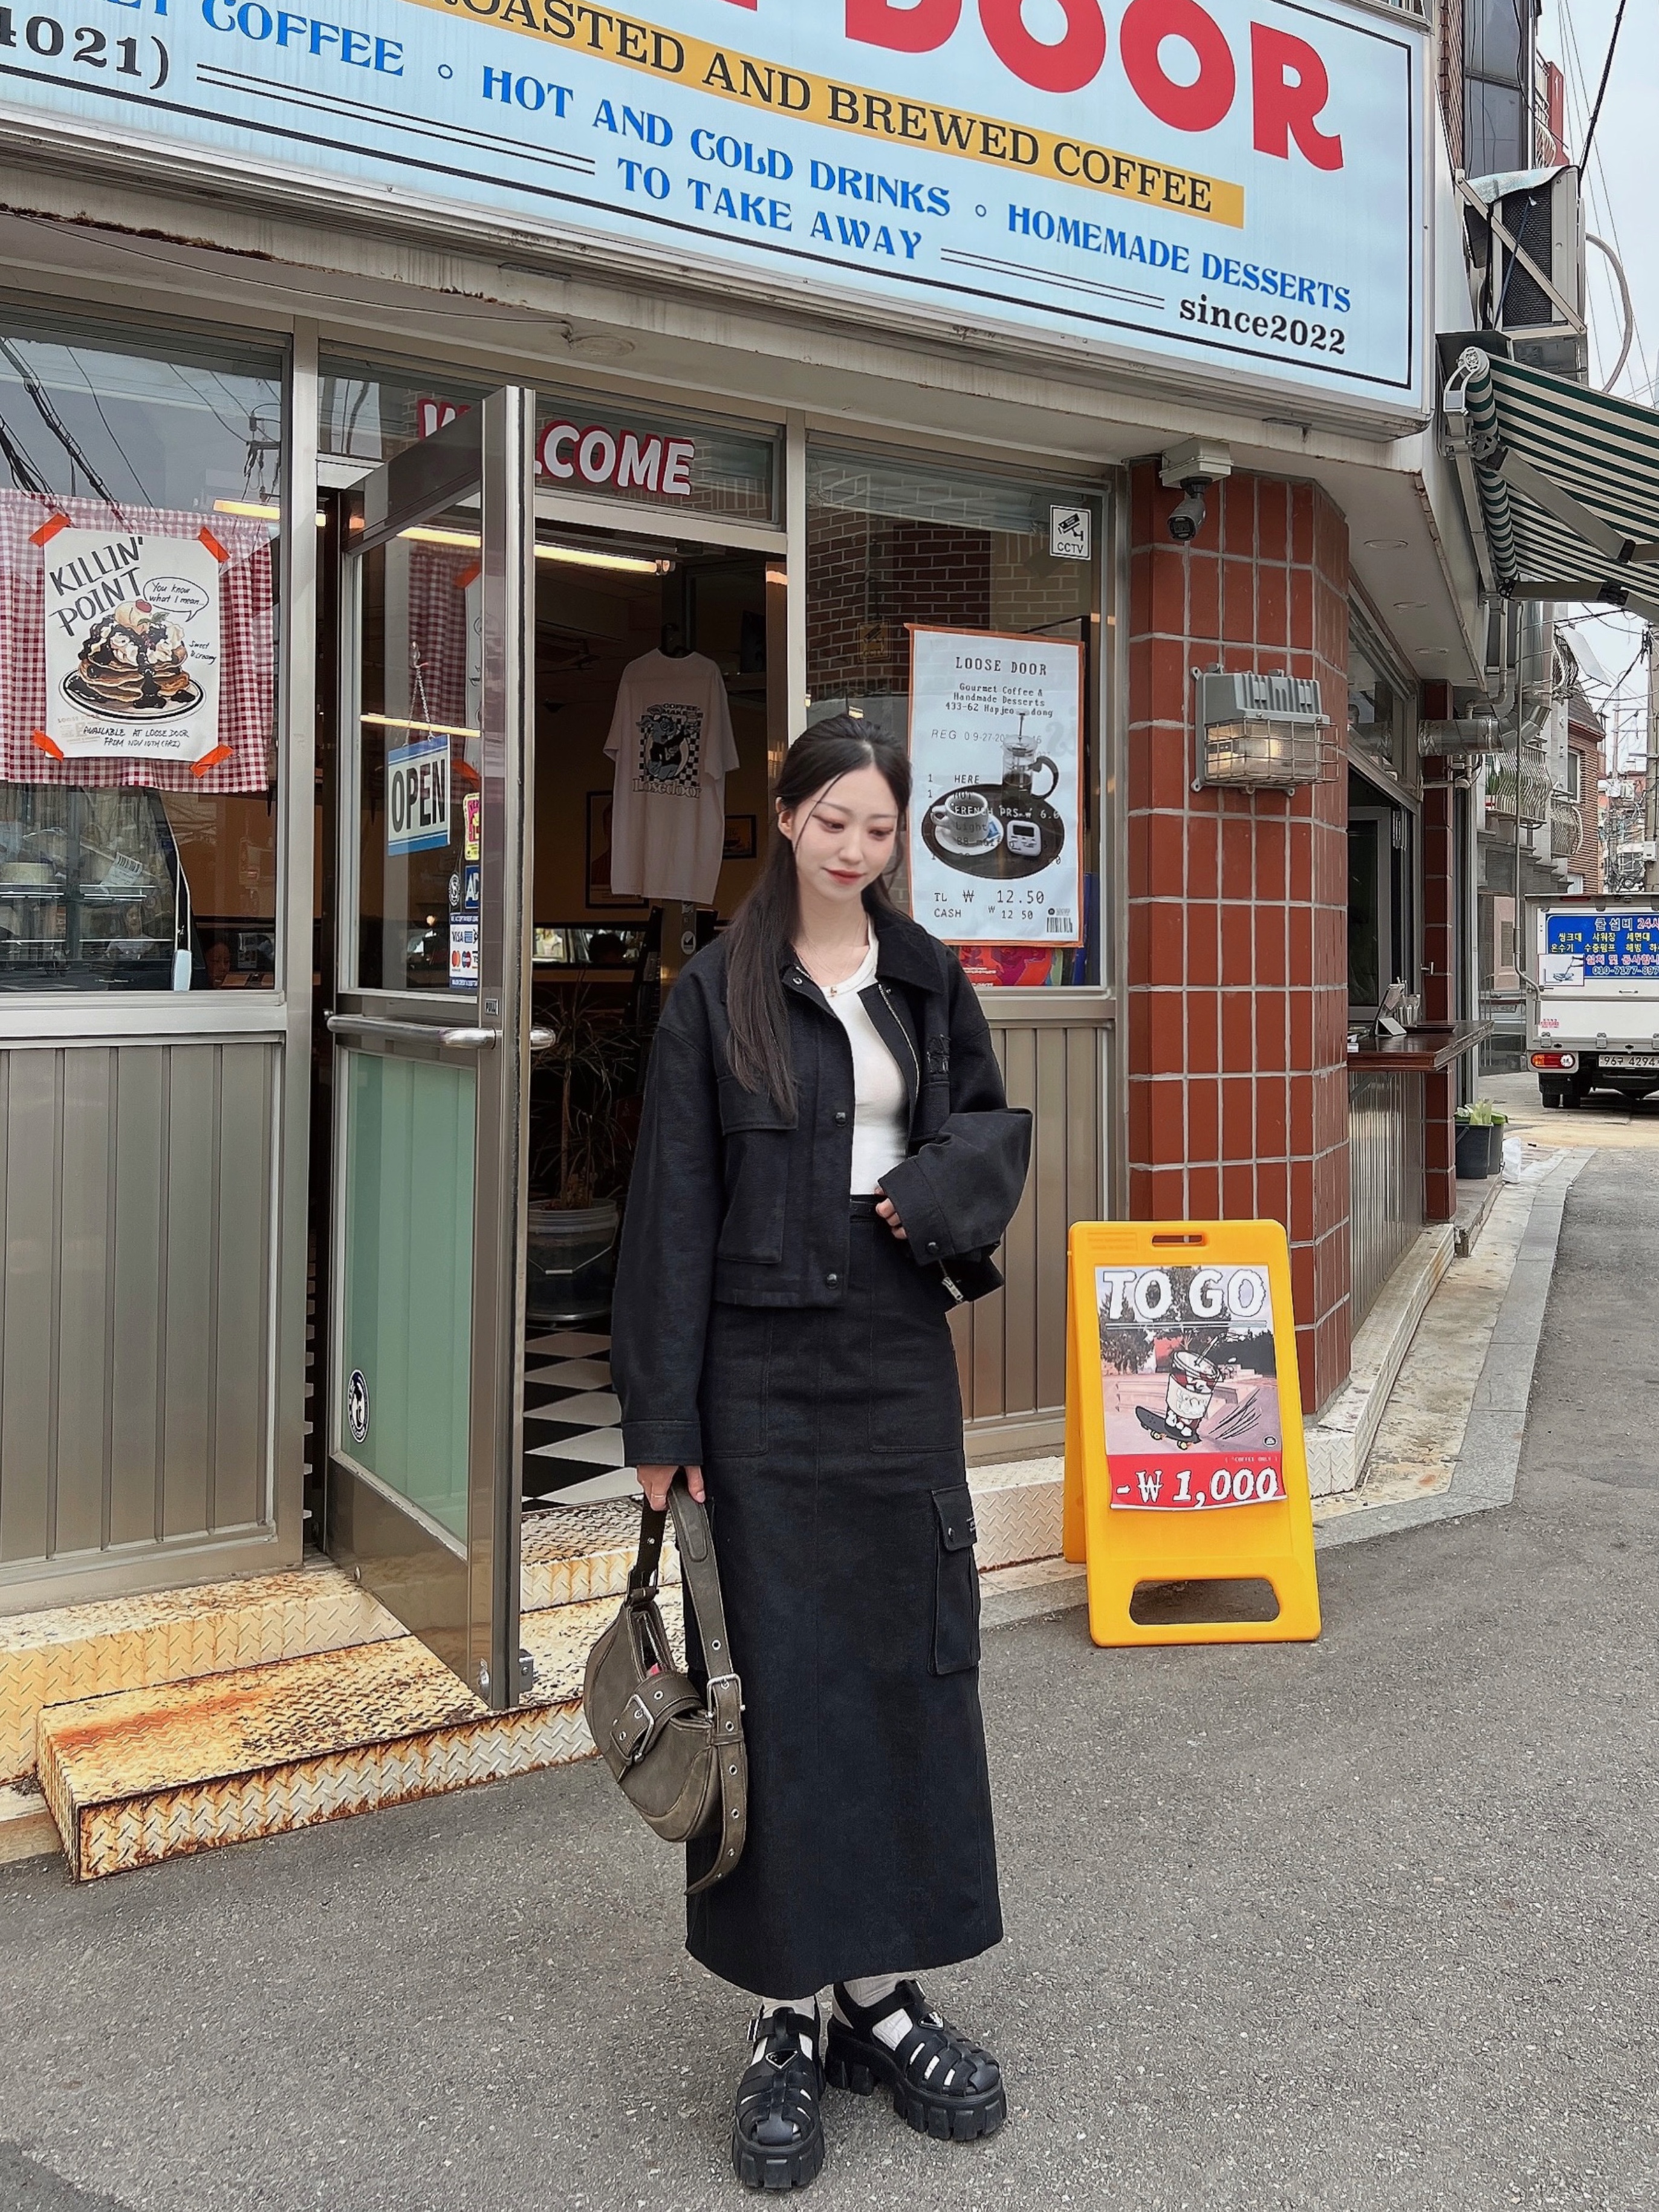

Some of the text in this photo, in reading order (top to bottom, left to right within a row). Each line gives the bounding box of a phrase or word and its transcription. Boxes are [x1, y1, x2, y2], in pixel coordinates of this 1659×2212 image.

[445, 0, 1212, 213] ASTED AND BREWED COFFEE
[203, 0, 1352, 314] COFFEE HOT AND COLD DRINKS HOMEMADE DESSERTS
[617, 158, 922, 261] TO TAKE AWAY
[1180, 294, 1346, 356] since2022
[1057, 541, 1084, 554] CCTV
[49, 536, 144, 596] KILLIN'
[152, 582, 190, 594] You know
[48, 567, 141, 637] POINT
[149, 593, 170, 603] what
[189, 640, 210, 649] Sweet
[956, 657, 1047, 675] LOOSE DOOR
[959, 682, 998, 693] Gourmet
[1002, 686, 1034, 697] Coffee
[953, 692, 1045, 707] Handmade Desserts
[945, 701, 979, 712] 433-62
[83, 726, 126, 737] AVAILABLE
[931, 729, 957, 740] REG
[104, 737, 124, 746] FROM
[954, 775, 980, 784] HERE
[391, 759, 446, 833] OPEN
[934, 893, 948, 902] TL
[997, 890, 1045, 903] 12.50
[934, 908, 962, 917] CASH
[451, 930, 464, 943] VISA
[1551, 944, 1574, 953] 온수기
[1628, 1056, 1655, 1067] 4294
[1103, 1269, 1267, 1321] TO GO
[1172, 1466, 1279, 1508] 1,000
